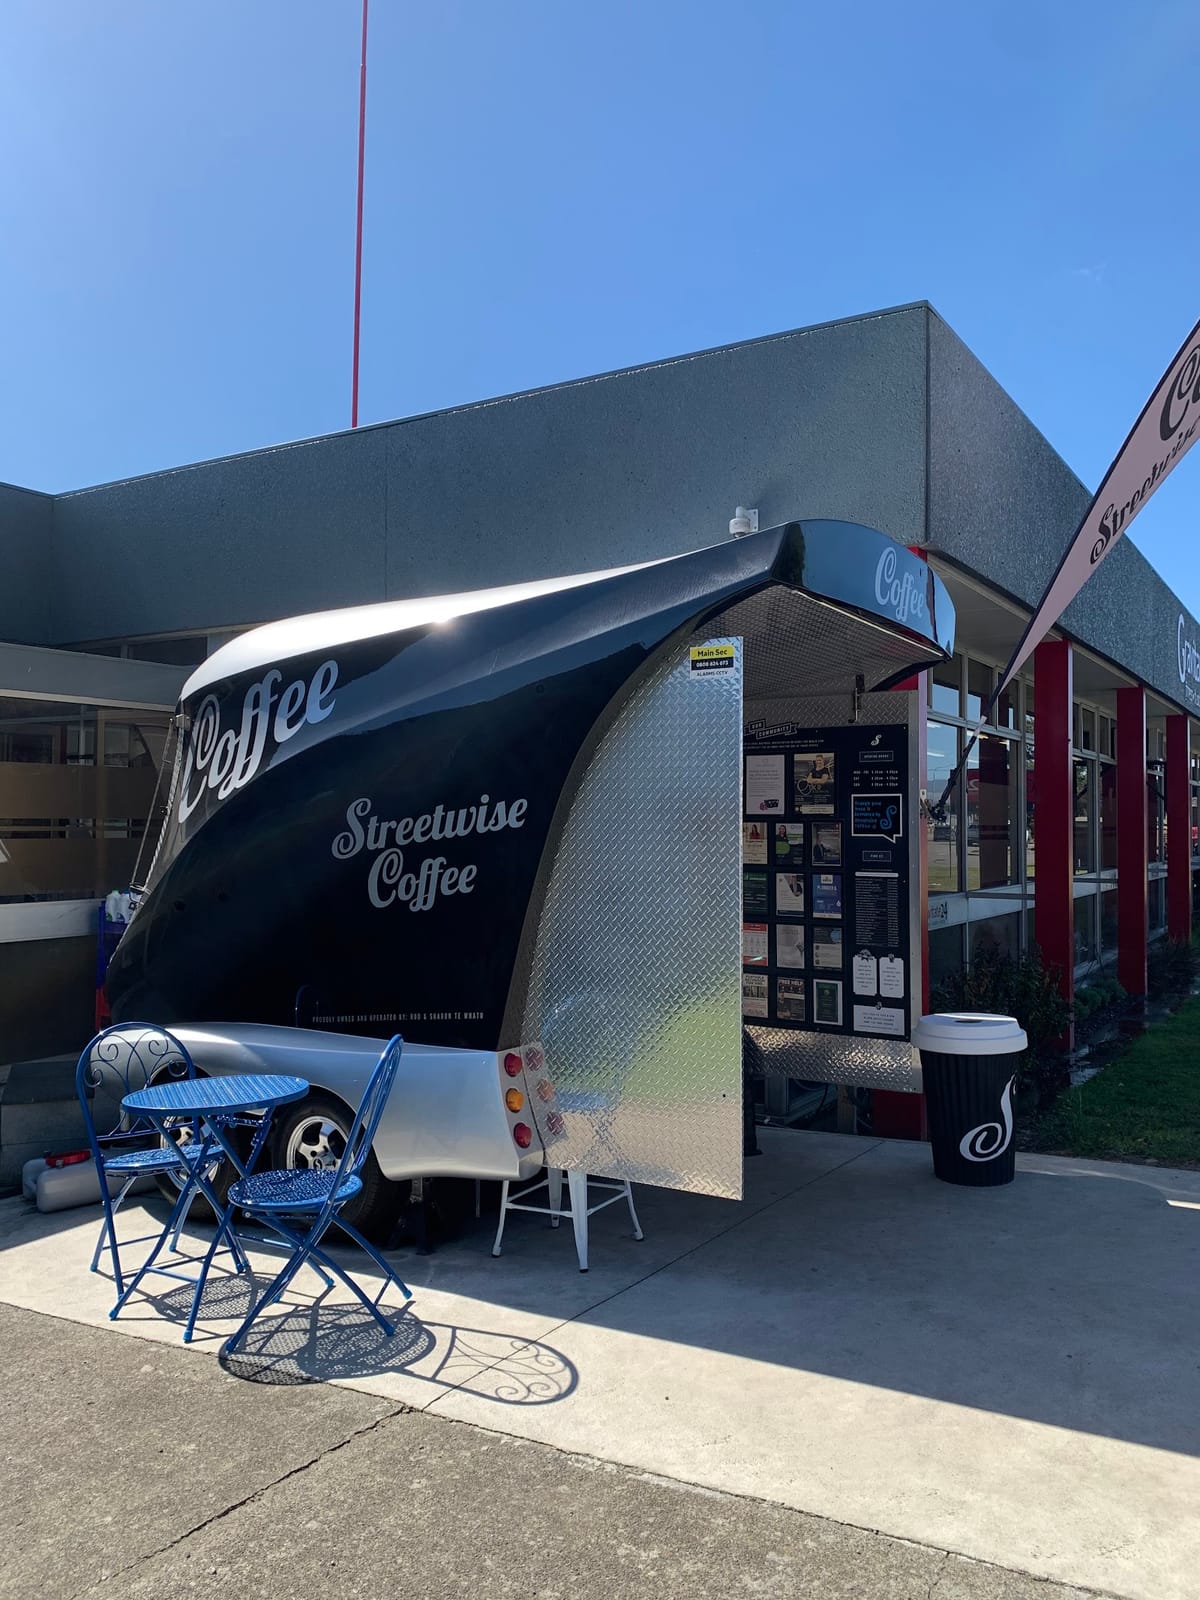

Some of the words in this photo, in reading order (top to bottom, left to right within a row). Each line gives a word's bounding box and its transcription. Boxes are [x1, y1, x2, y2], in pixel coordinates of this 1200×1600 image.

[874, 546, 924, 622] Coffee
[697, 649, 715, 657] Main
[715, 648, 728, 656] Sec
[178, 659, 340, 824] Coffee
[331, 794, 528, 859] Streetwise
[367, 848, 478, 912] Coffee
